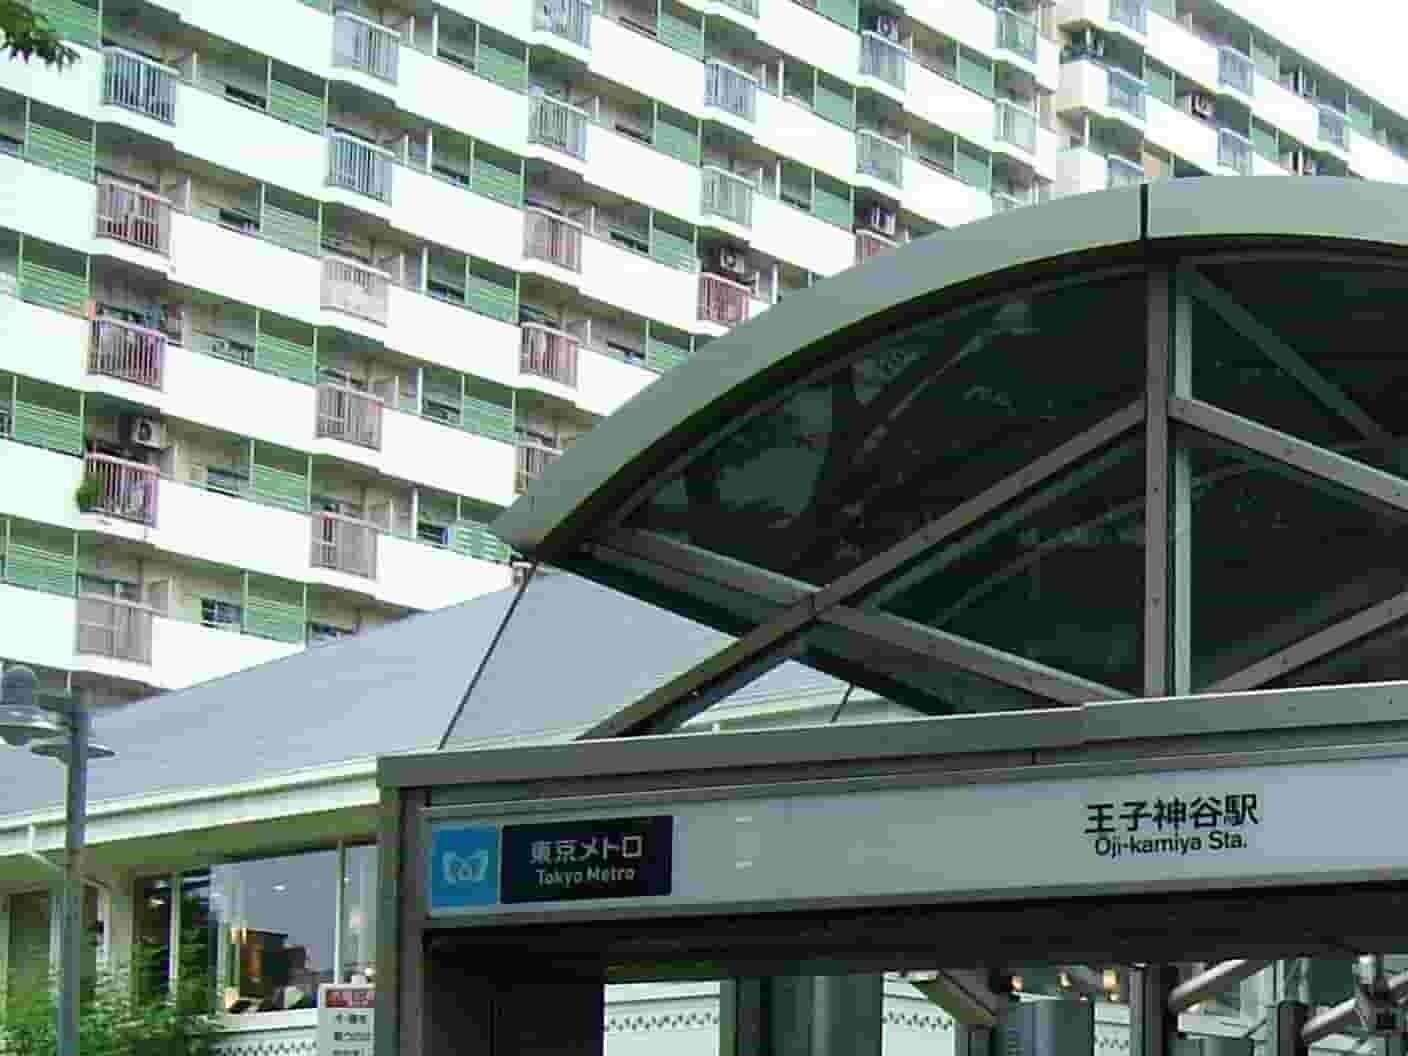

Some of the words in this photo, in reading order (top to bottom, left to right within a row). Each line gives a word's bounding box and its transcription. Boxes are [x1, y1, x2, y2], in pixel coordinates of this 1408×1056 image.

[1084, 793, 1259, 833] 王子神谷駅
[529, 836, 642, 863] 東京メトロ
[1095, 834, 1202, 859] Oji-kamiya
[1208, 831, 1248, 850] Sta.
[536, 867, 583, 887] Tokyo
[587, 863, 635, 881] Metro
